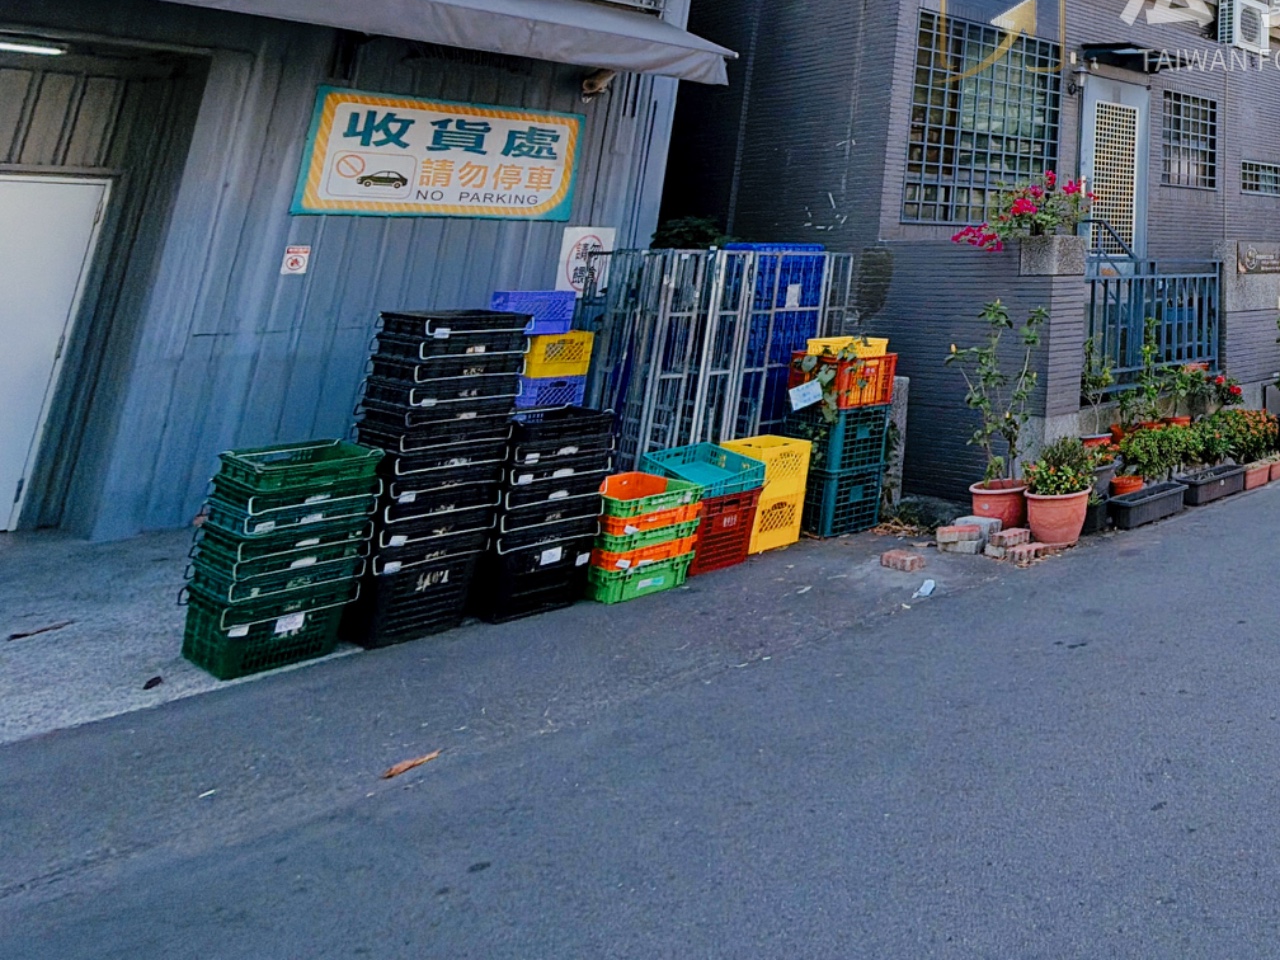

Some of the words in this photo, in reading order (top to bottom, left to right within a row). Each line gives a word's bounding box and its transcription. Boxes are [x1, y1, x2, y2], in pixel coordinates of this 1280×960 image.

[343, 109, 561, 161] 收貨處
[418, 158, 556, 193] 請勿停車
[415, 189, 444, 202] NO
[458, 191, 539, 205] PARKING
